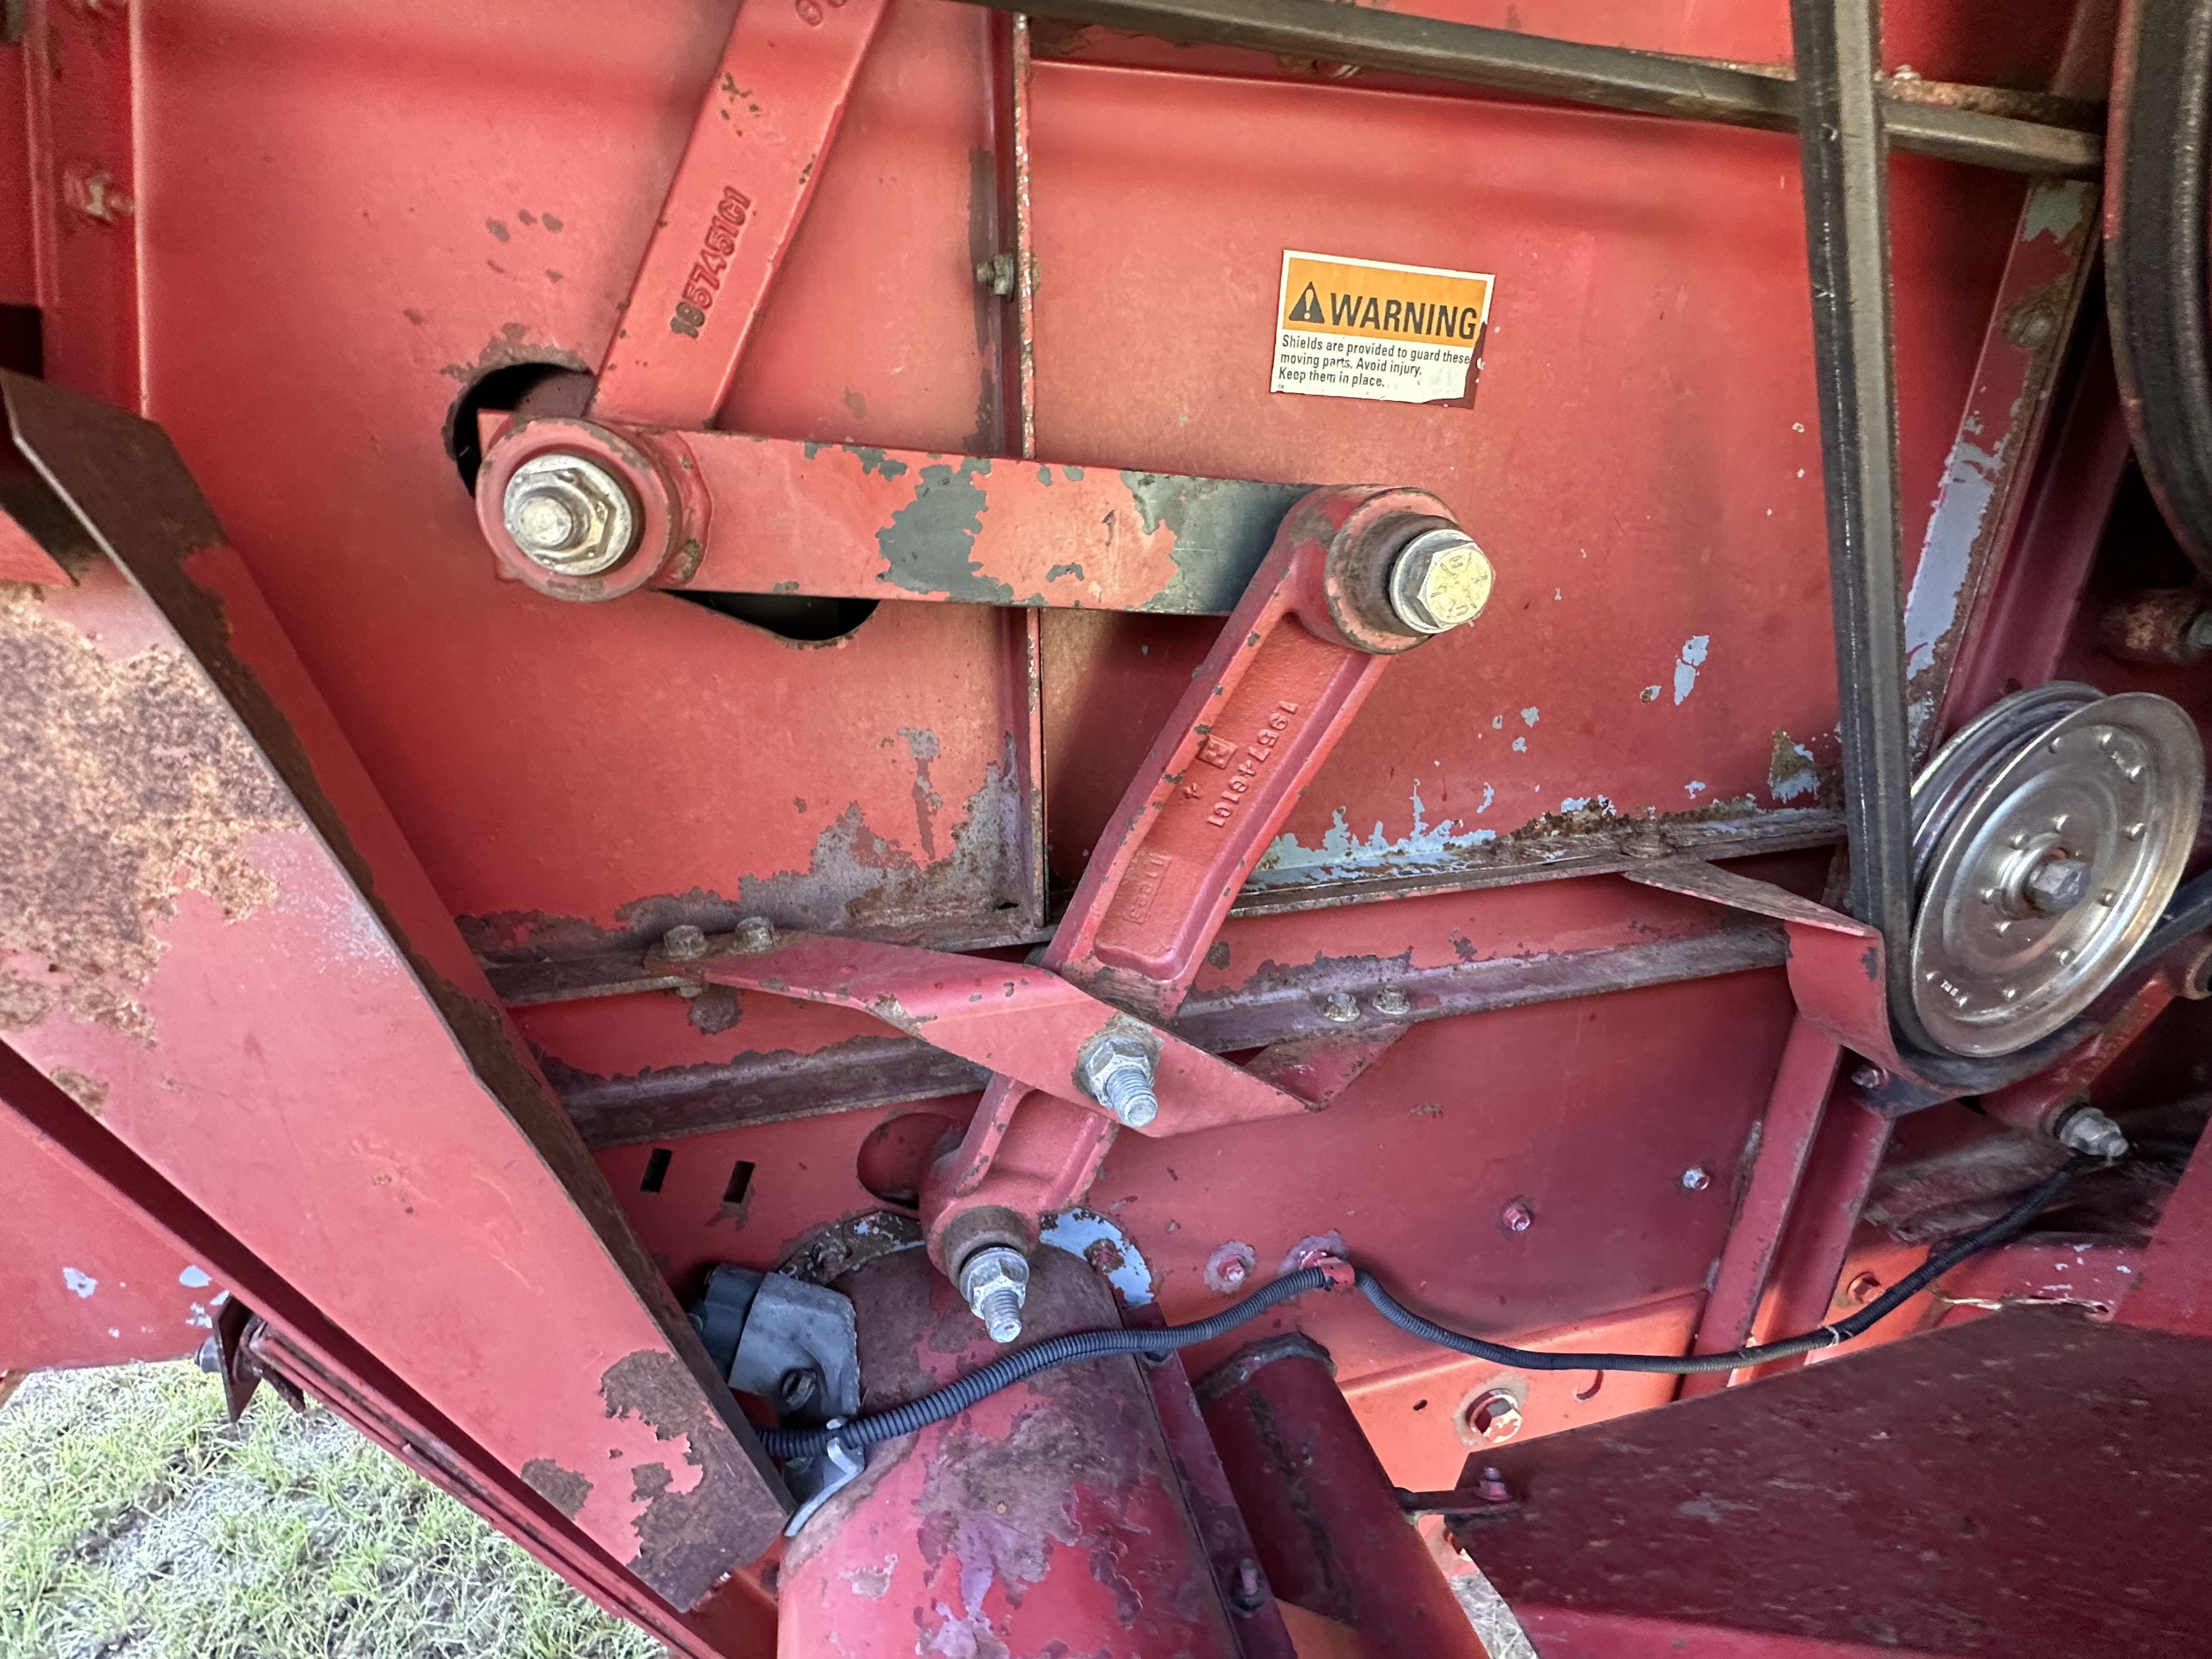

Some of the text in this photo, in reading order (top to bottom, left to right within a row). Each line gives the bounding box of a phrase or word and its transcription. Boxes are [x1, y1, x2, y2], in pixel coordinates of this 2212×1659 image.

[1330, 292, 1477, 340] WARNING
[1283, 335, 1470, 364] Shields are provided to guard these
[1279, 367, 1384, 387] Keep them in place.
[1281, 352, 1421, 377] moving parts. Avoid injury.
